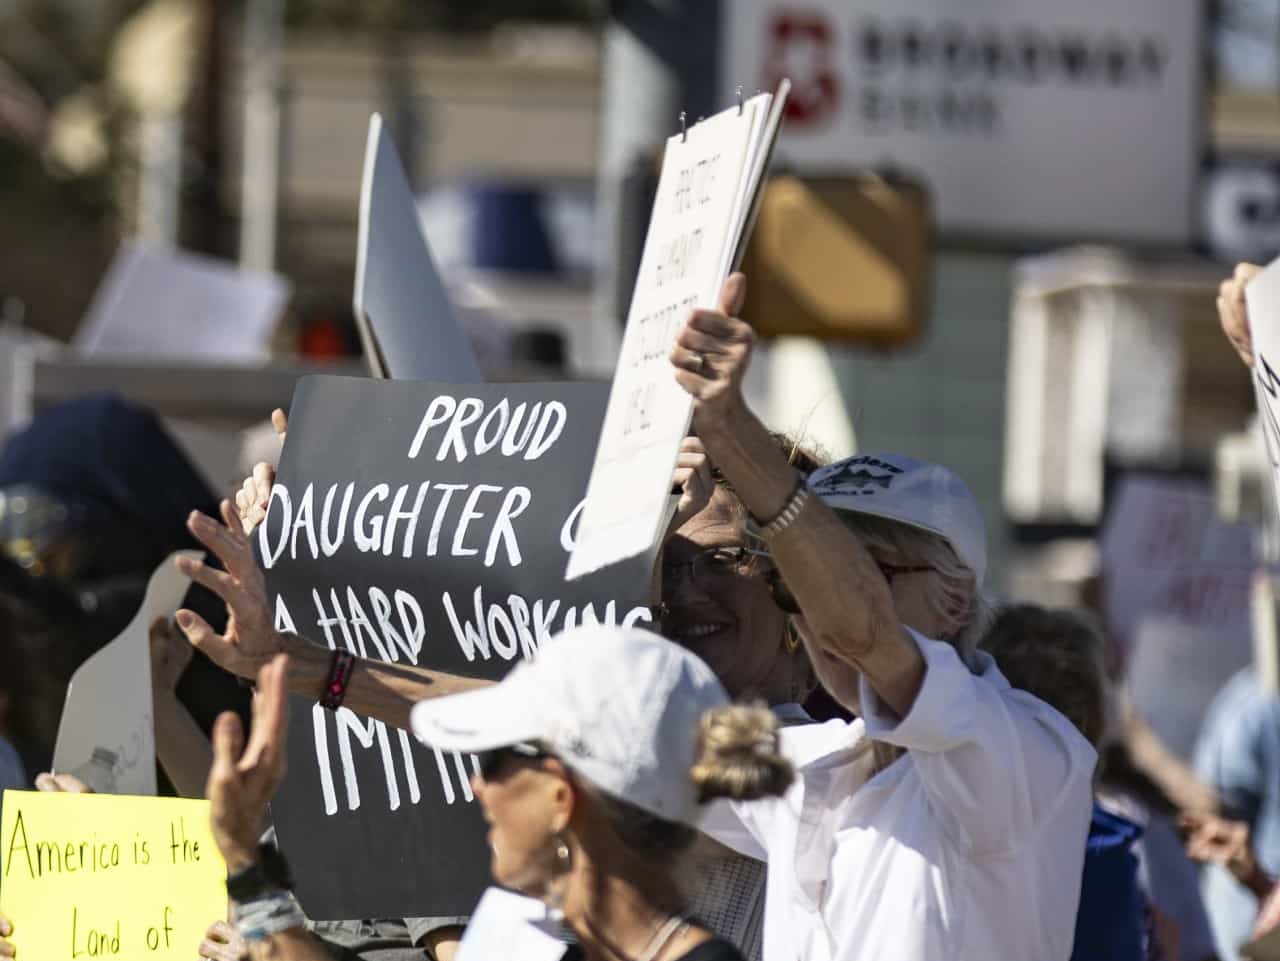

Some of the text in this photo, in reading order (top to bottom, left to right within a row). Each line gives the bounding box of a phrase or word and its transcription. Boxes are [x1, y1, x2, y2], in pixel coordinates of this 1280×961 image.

[408, 395, 567, 462] PROUD
[258, 480, 532, 569] DAUGHTER
[312, 585, 426, 666] HARD
[6, 809, 201, 879] America is the
[72, 906, 173, 958] Land of
